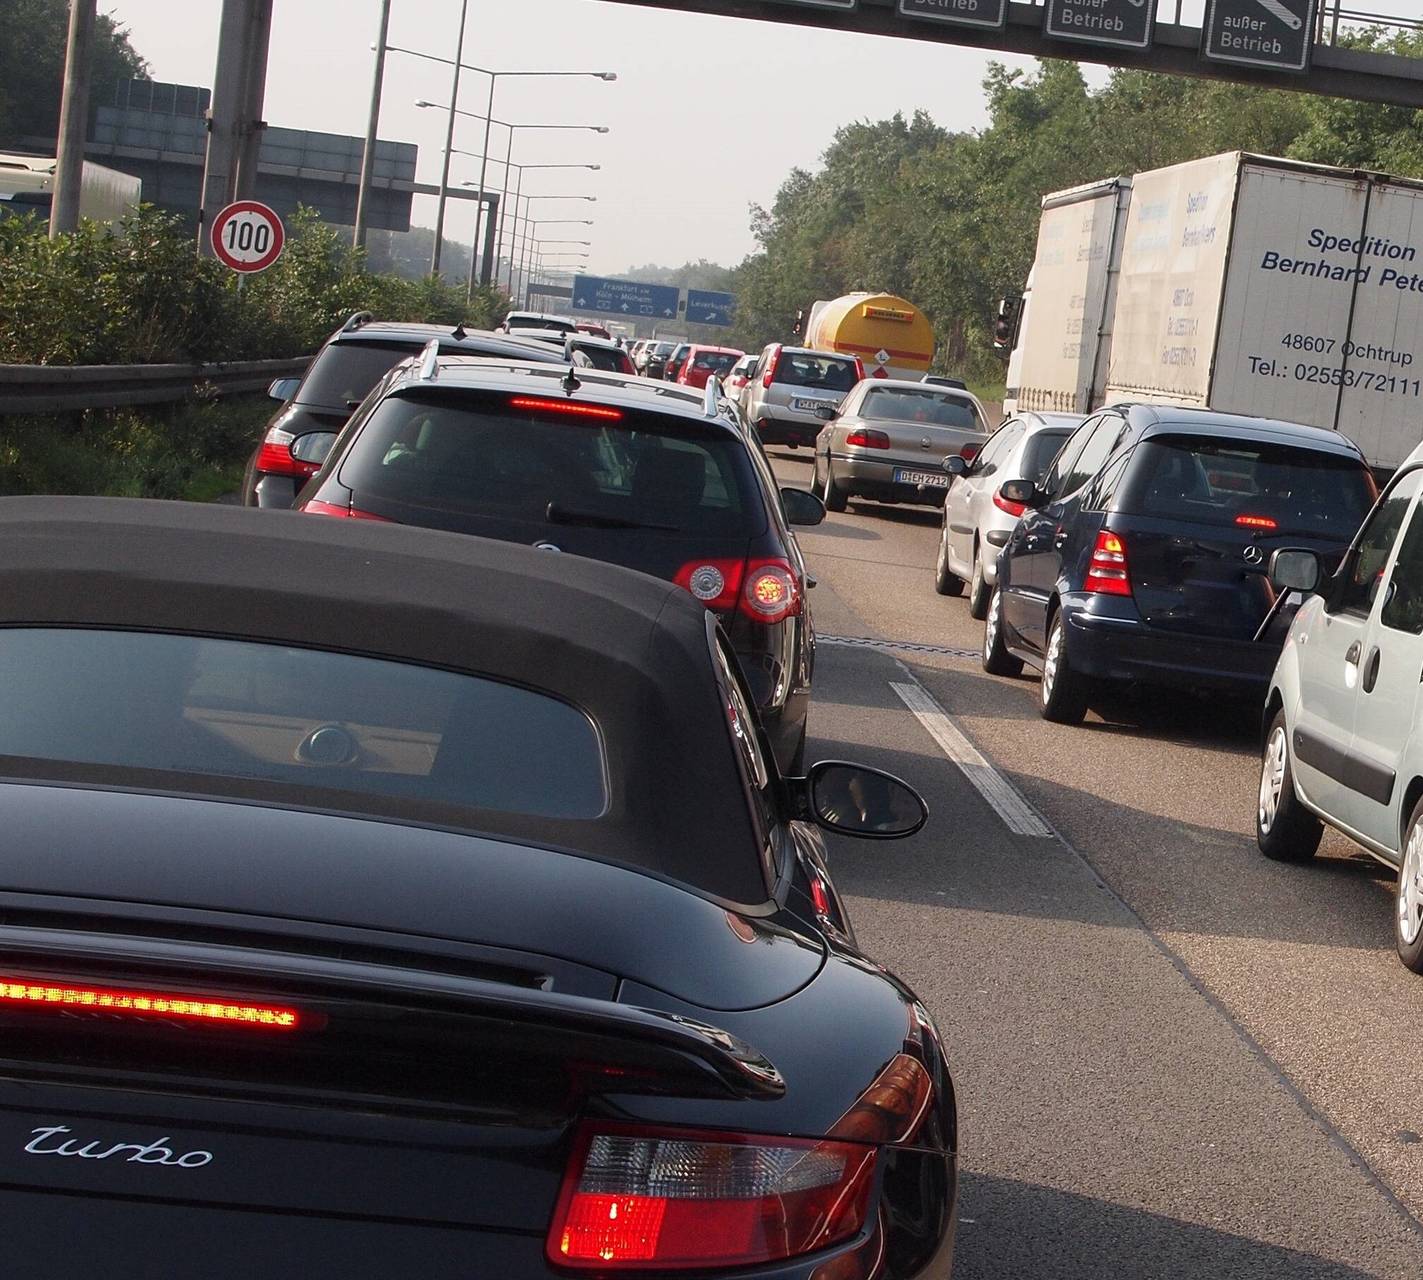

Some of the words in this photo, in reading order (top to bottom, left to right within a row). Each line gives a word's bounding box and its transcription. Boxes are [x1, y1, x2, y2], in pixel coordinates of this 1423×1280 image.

[1061, 9, 1124, 32] Betrieb
[1223, 14, 1267, 31] außer
[1220, 32, 1282, 54] Betrieb
[228, 220, 270, 254] 100
[1307, 228, 1416, 261] Spedition
[1260, 251, 1372, 284] Bernhard
[1281, 333, 1335, 354] 48607
[1342, 340, 1413, 367] Ochtrup
[1248, 356, 1287, 378] Tel.:
[24, 1125, 214, 1168] turbo
